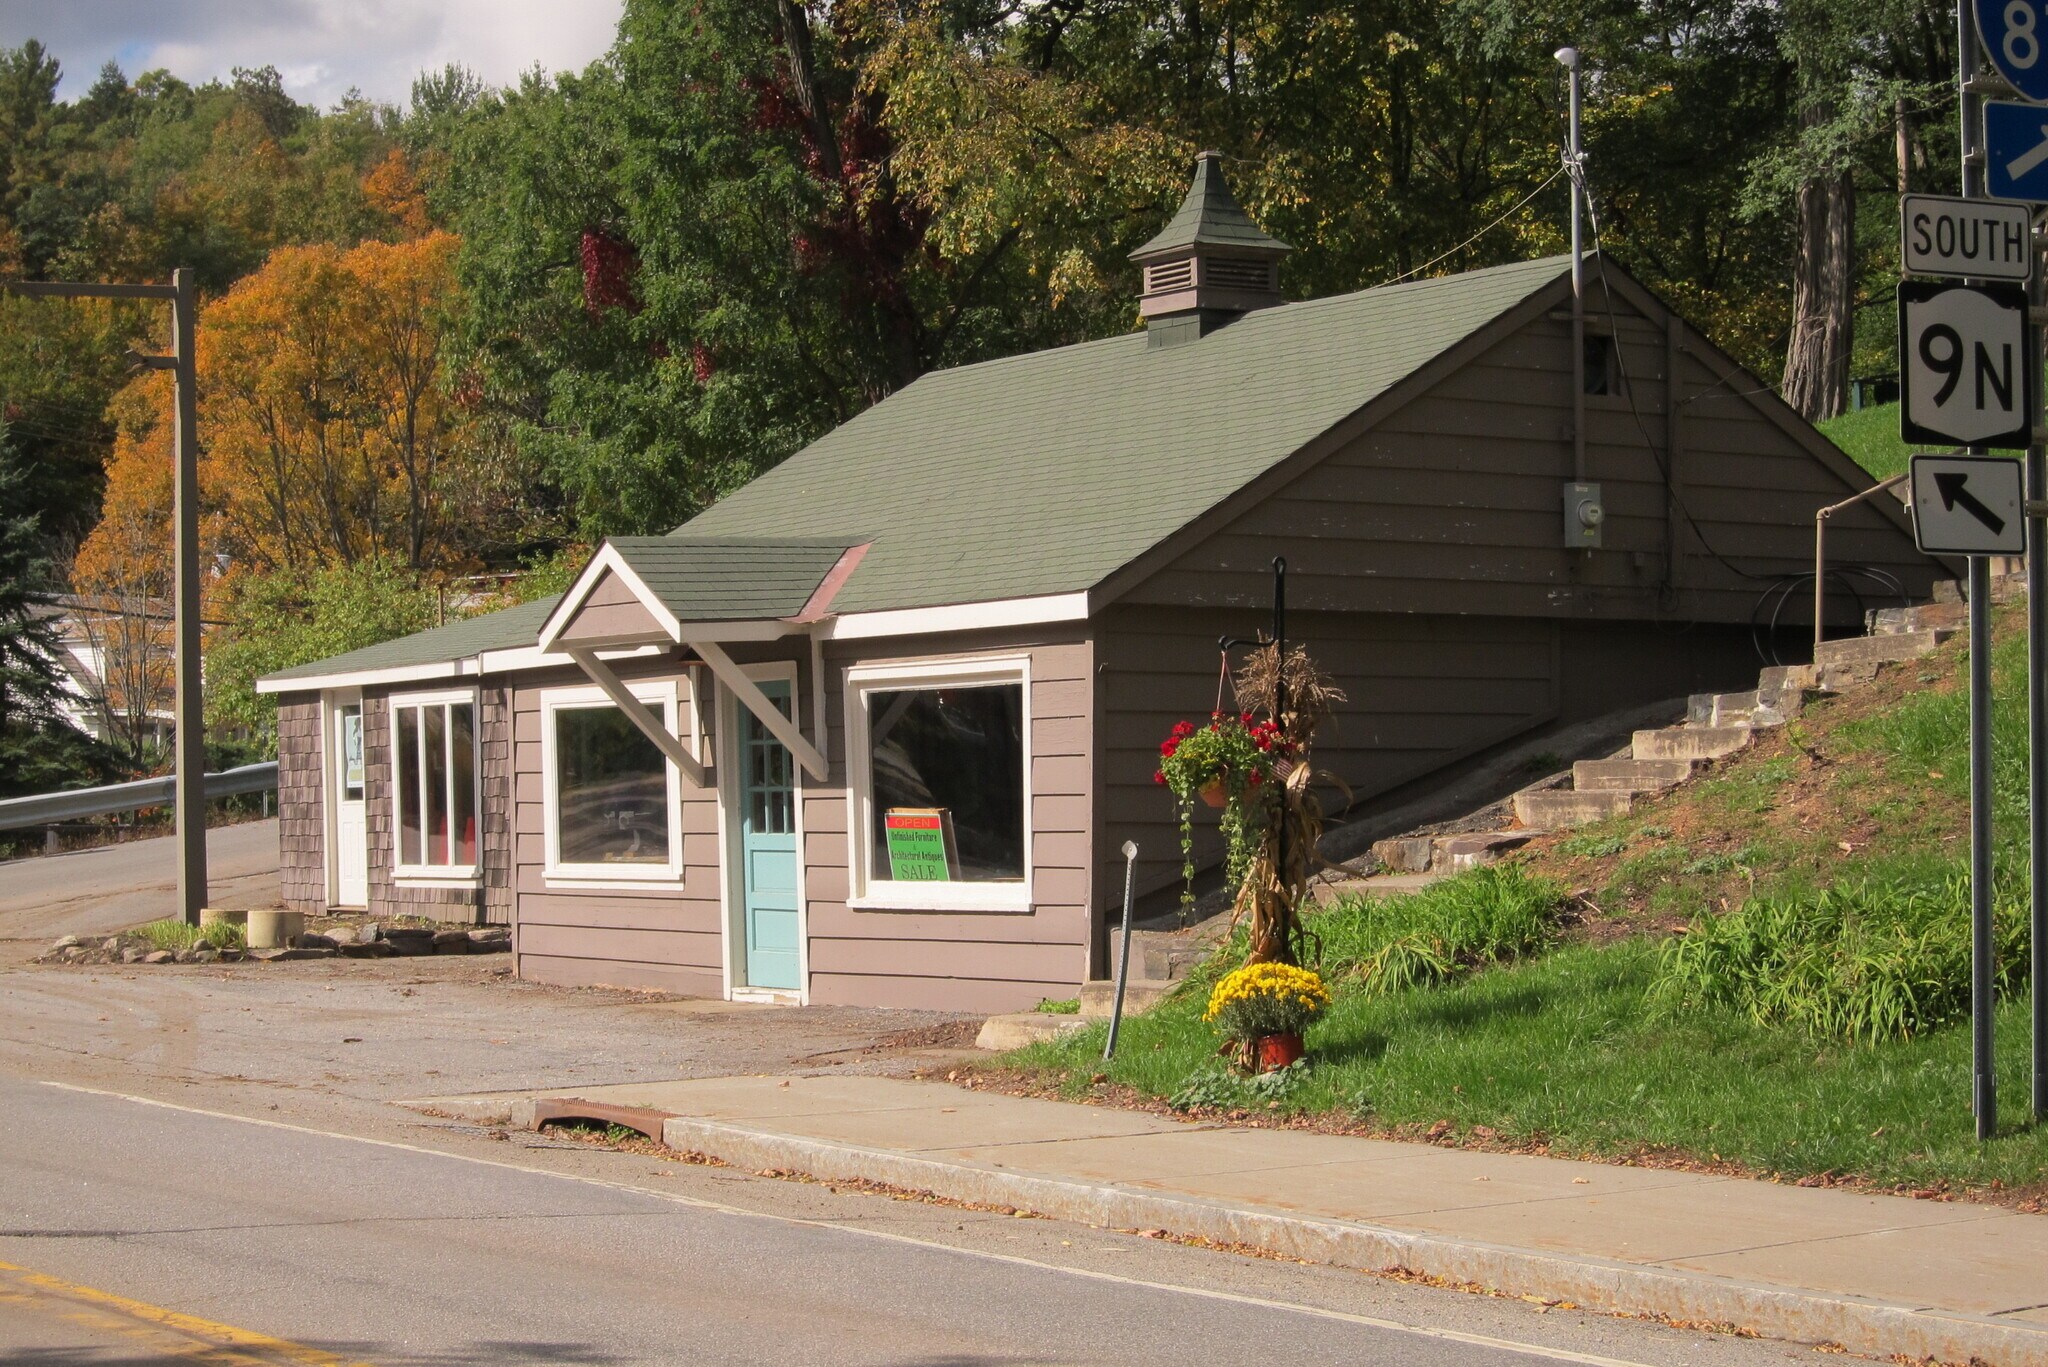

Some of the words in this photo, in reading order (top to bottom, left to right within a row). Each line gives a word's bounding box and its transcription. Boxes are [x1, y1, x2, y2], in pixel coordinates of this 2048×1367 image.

[2003, 0, 2048, 69] 8
[1913, 213, 2023, 263] SOUTH
[1918, 323, 2013, 412] 9N
[895, 818, 930, 828] OPEN
[891, 831, 914, 842] Unfinished
[915, 831, 937, 842] Furniture
[891, 850, 921, 861] Architectural
[922, 850, 944, 863] Antiques
[901, 864, 938, 881] SALE
